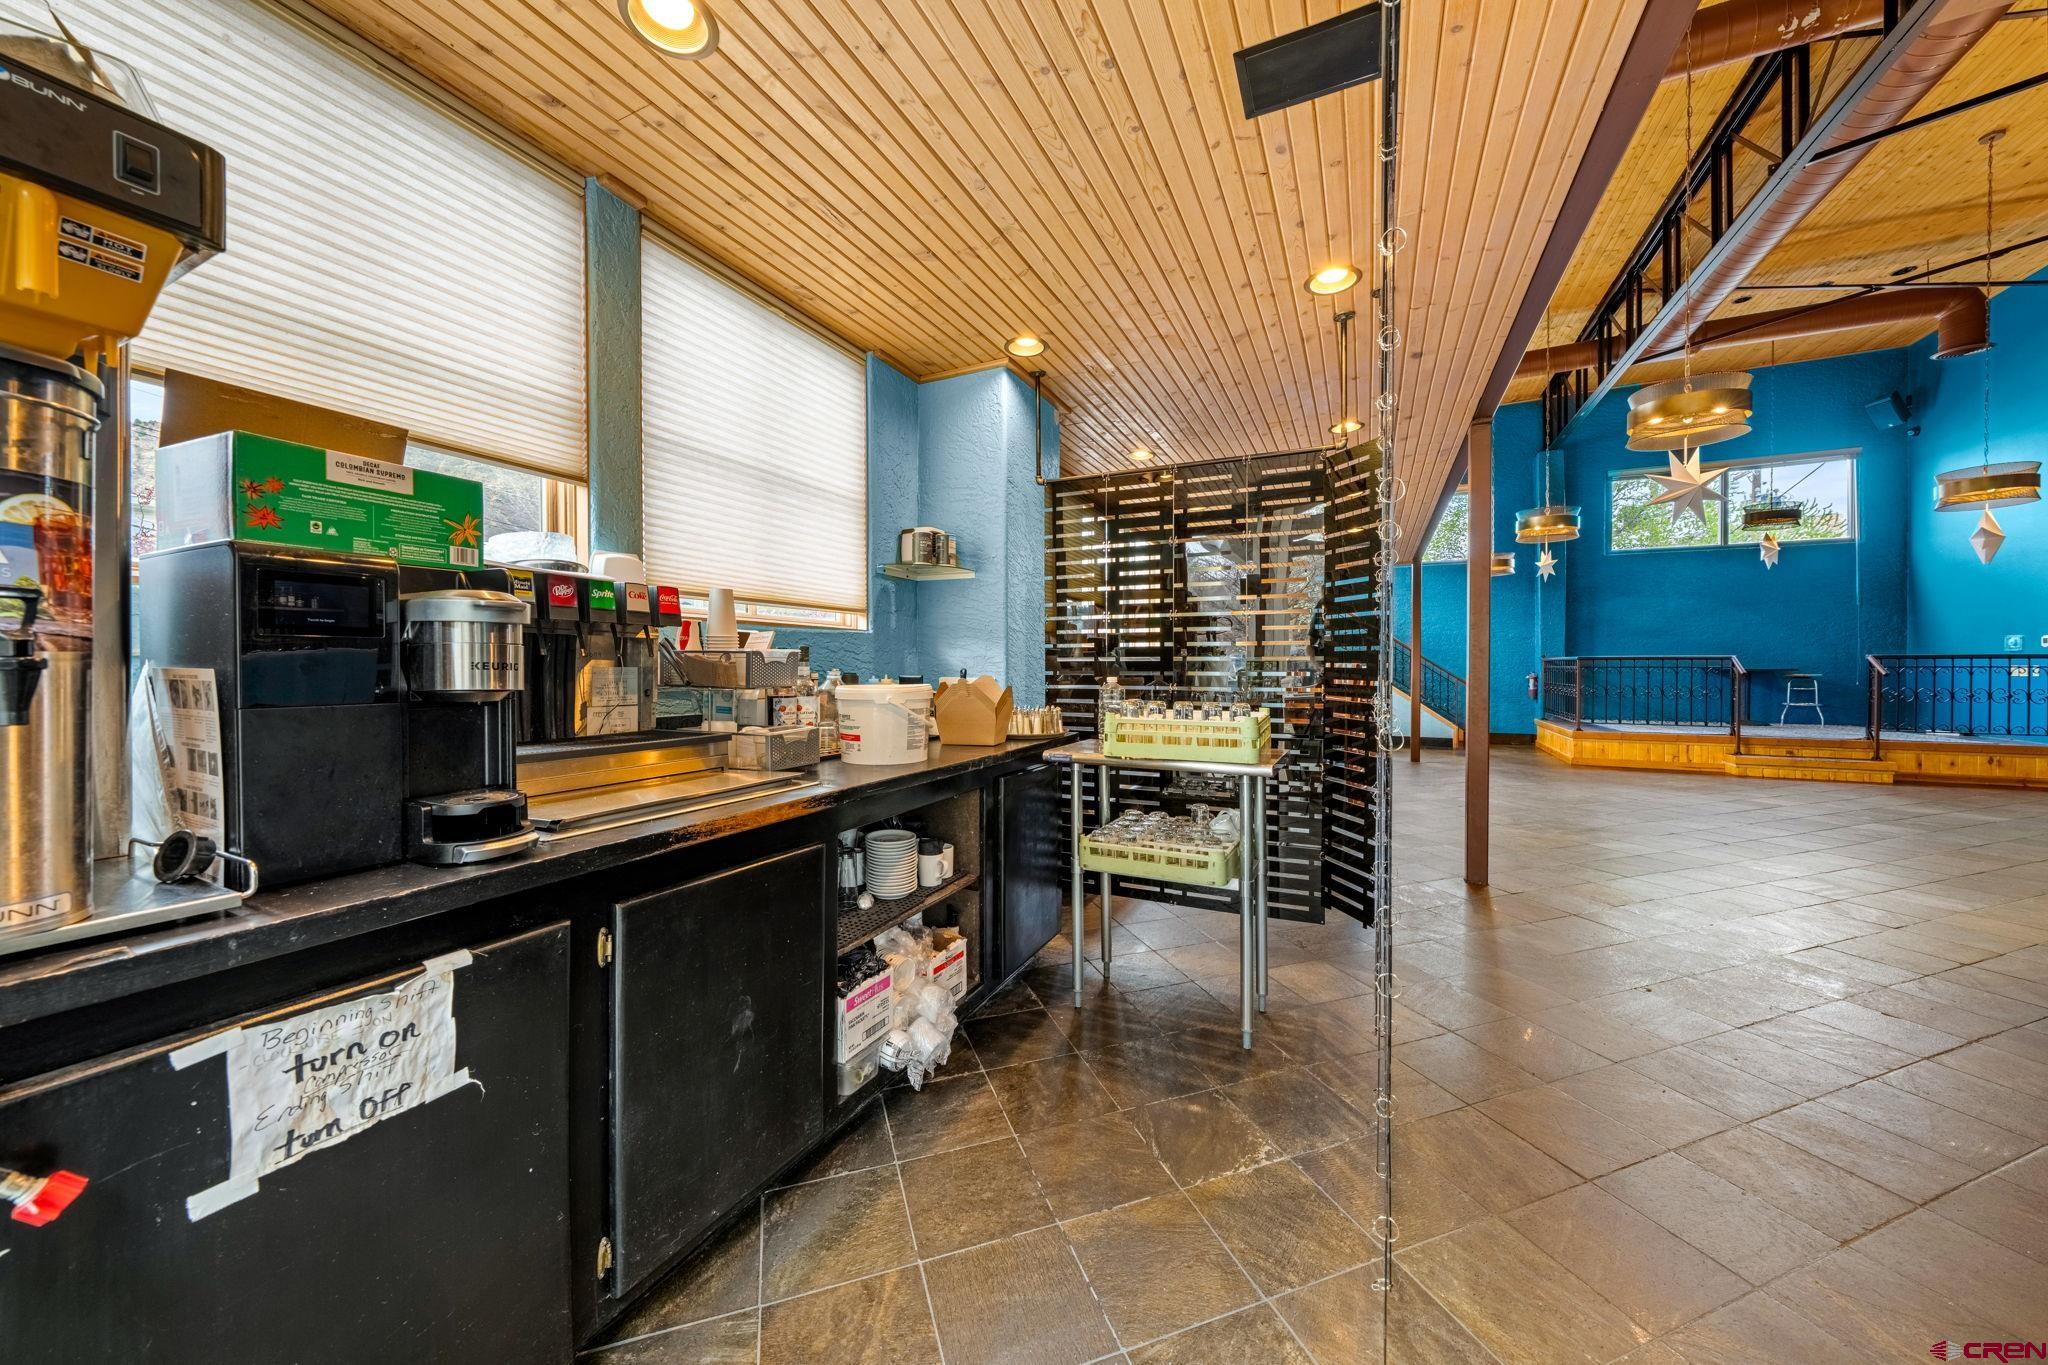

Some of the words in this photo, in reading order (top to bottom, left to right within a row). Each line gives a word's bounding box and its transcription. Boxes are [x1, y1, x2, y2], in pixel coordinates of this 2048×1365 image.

[11, 73, 87, 112] BUNN
[335, 461, 374, 474] COLOMBIAN
[376, 469, 406, 481] SUPREMO
[363, 460, 380, 469] DECAF
[555, 586, 574, 596] Pepper
[592, 589, 614, 599] Sprite
[628, 590, 647, 600] Coke
[471, 661, 519, 671] KEURIG
[262, 1007, 373, 1050] Beginning
[283, 1042, 368, 1084] turn
[379, 1022, 422, 1048] on
[273, 1118, 344, 1160] turn
